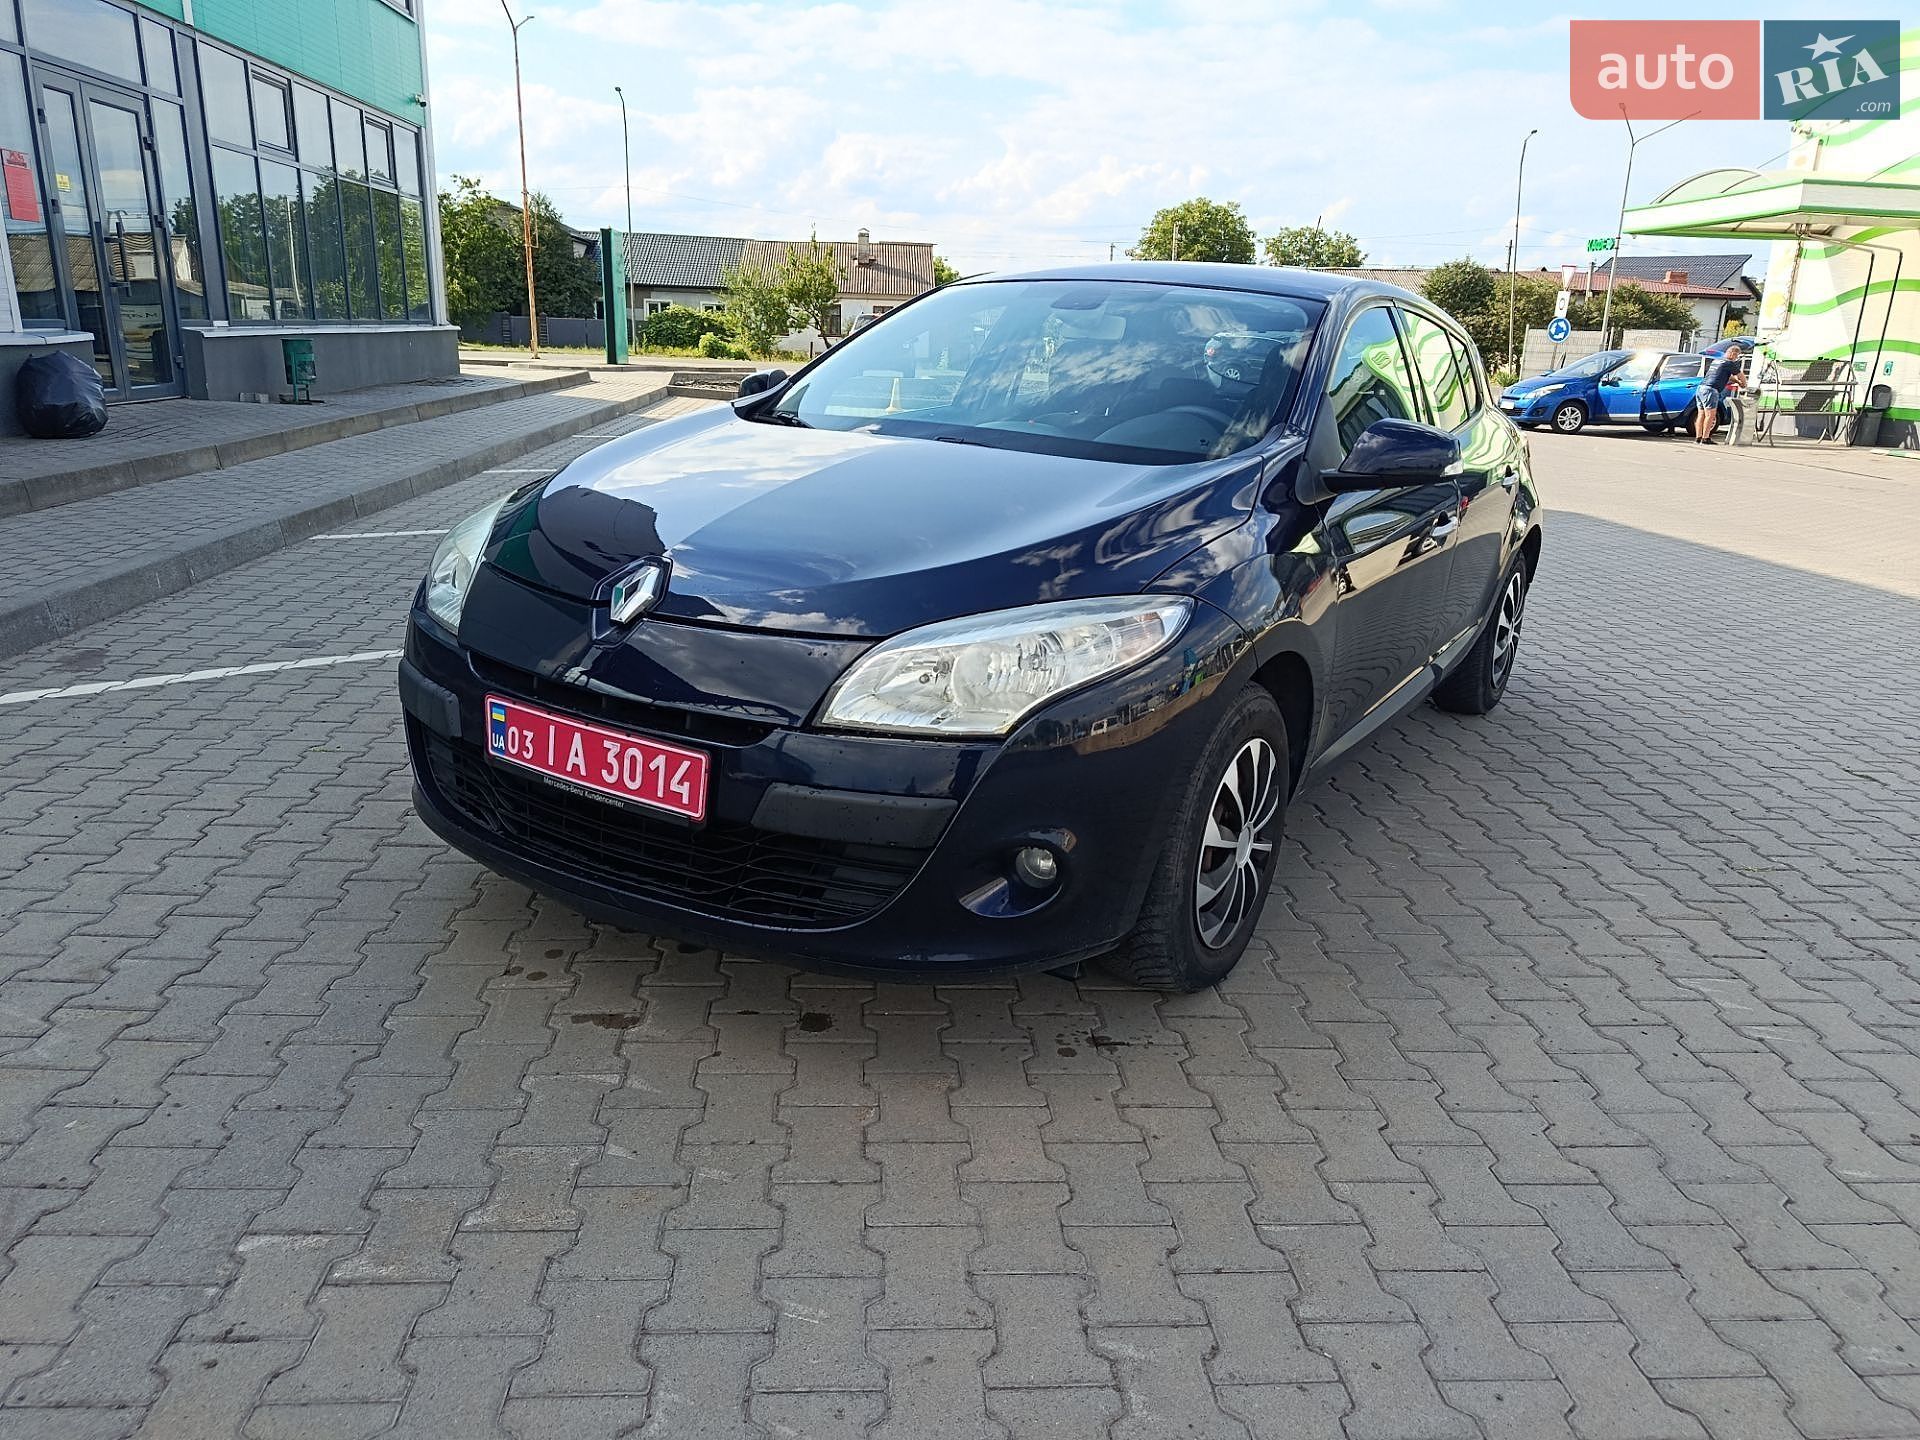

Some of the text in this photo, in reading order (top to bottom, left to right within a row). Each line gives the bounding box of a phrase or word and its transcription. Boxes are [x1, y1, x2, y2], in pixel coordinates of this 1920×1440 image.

[492, 732, 506, 751] UA
[508, 726, 534, 760] 03
[601, 739, 691, 805] 3014
[543, 776, 584, 797] Mercedes-Benz
